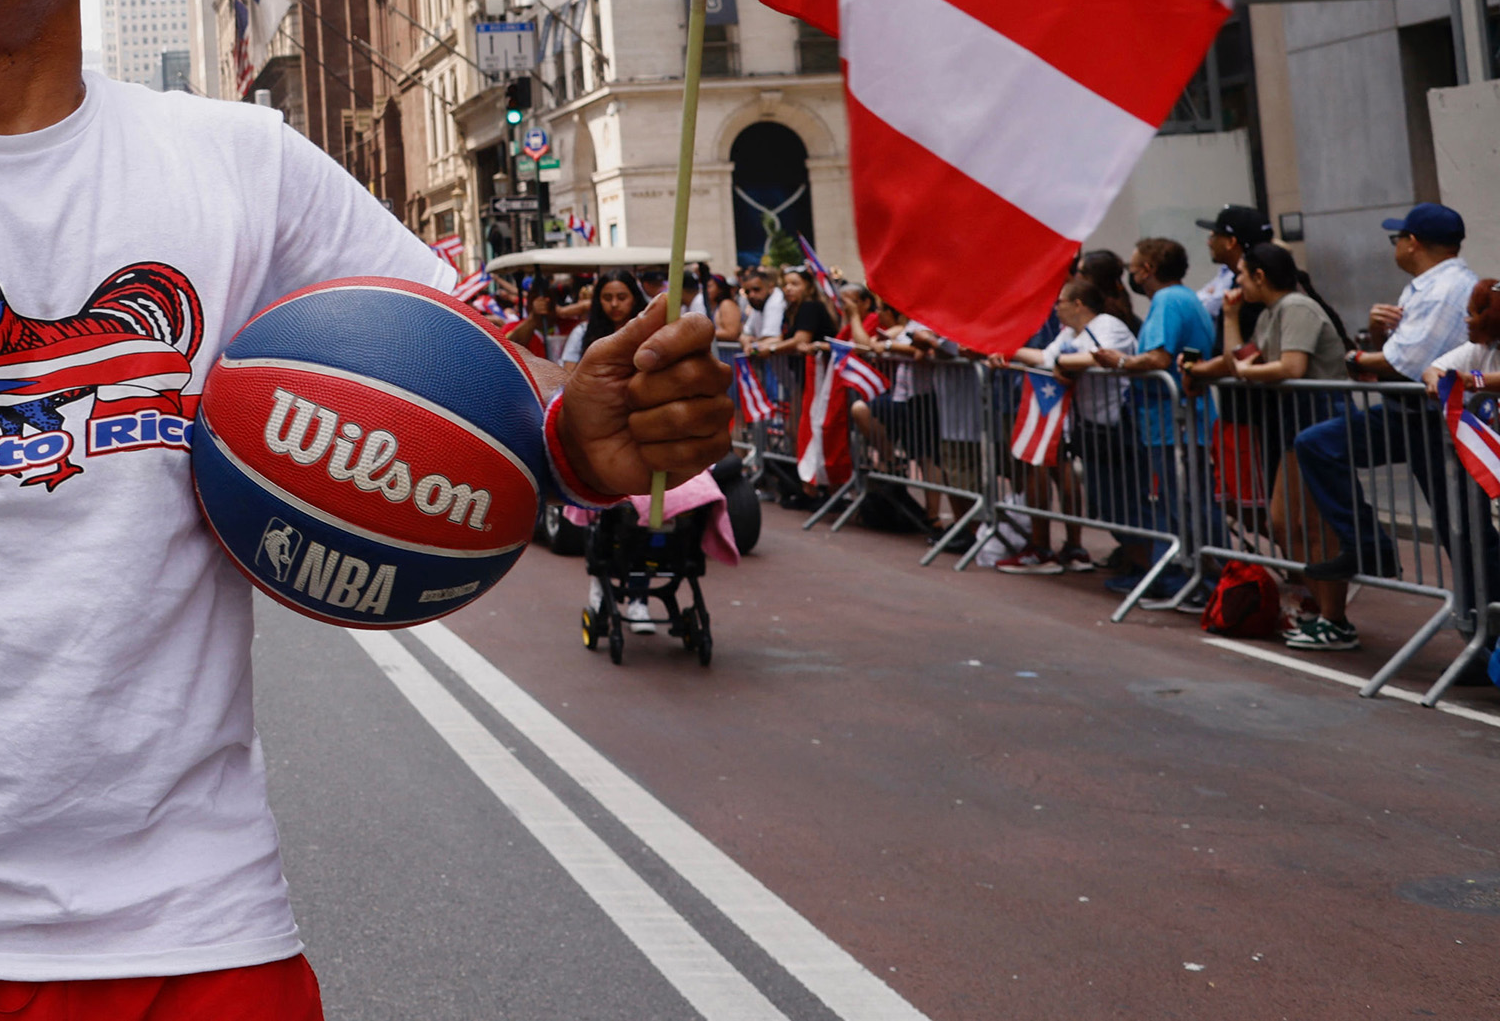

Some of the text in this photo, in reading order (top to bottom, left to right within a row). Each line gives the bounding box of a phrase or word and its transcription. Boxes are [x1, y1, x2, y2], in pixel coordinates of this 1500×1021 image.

[93, 411, 194, 451] Ric
[264, 387, 492, 532] Wilson
[293, 542, 398, 616] NBA
